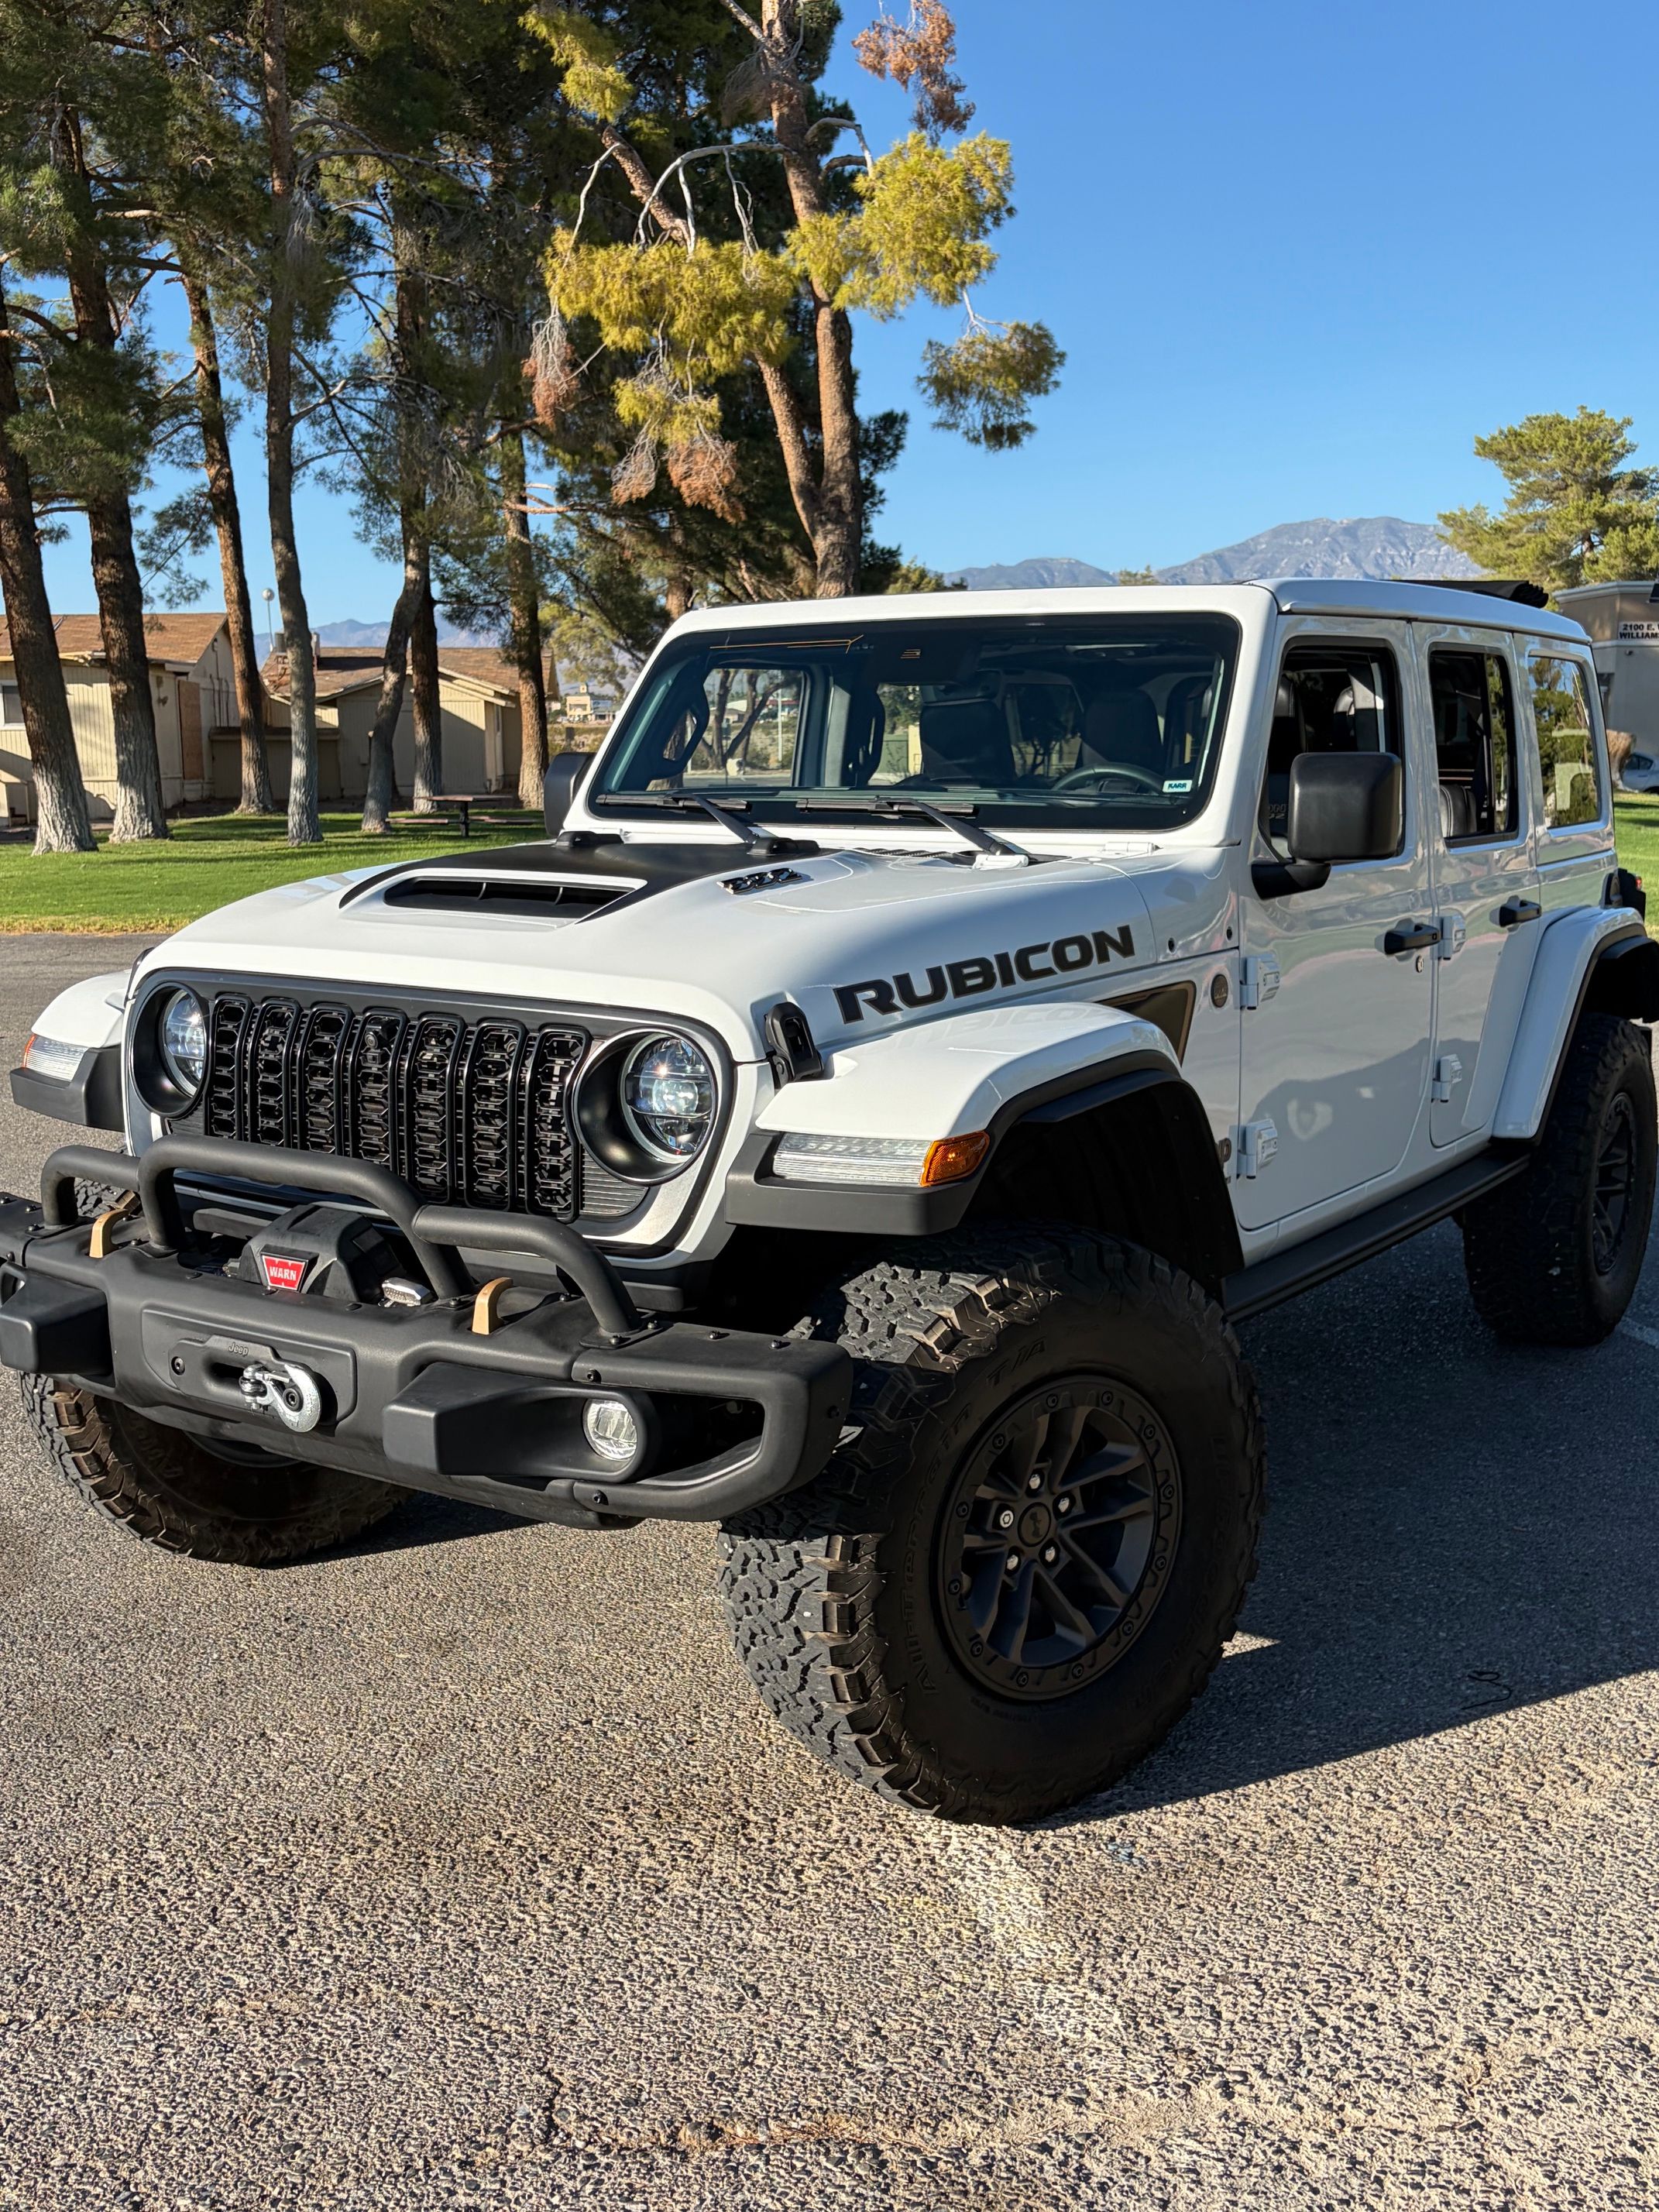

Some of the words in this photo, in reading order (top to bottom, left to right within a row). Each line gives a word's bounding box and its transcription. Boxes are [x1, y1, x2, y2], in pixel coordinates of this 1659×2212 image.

[833, 924, 1135, 1025] RUBICON
[270, 1266, 297, 1281] WARN
[228, 1341, 249, 1357] Jeep
